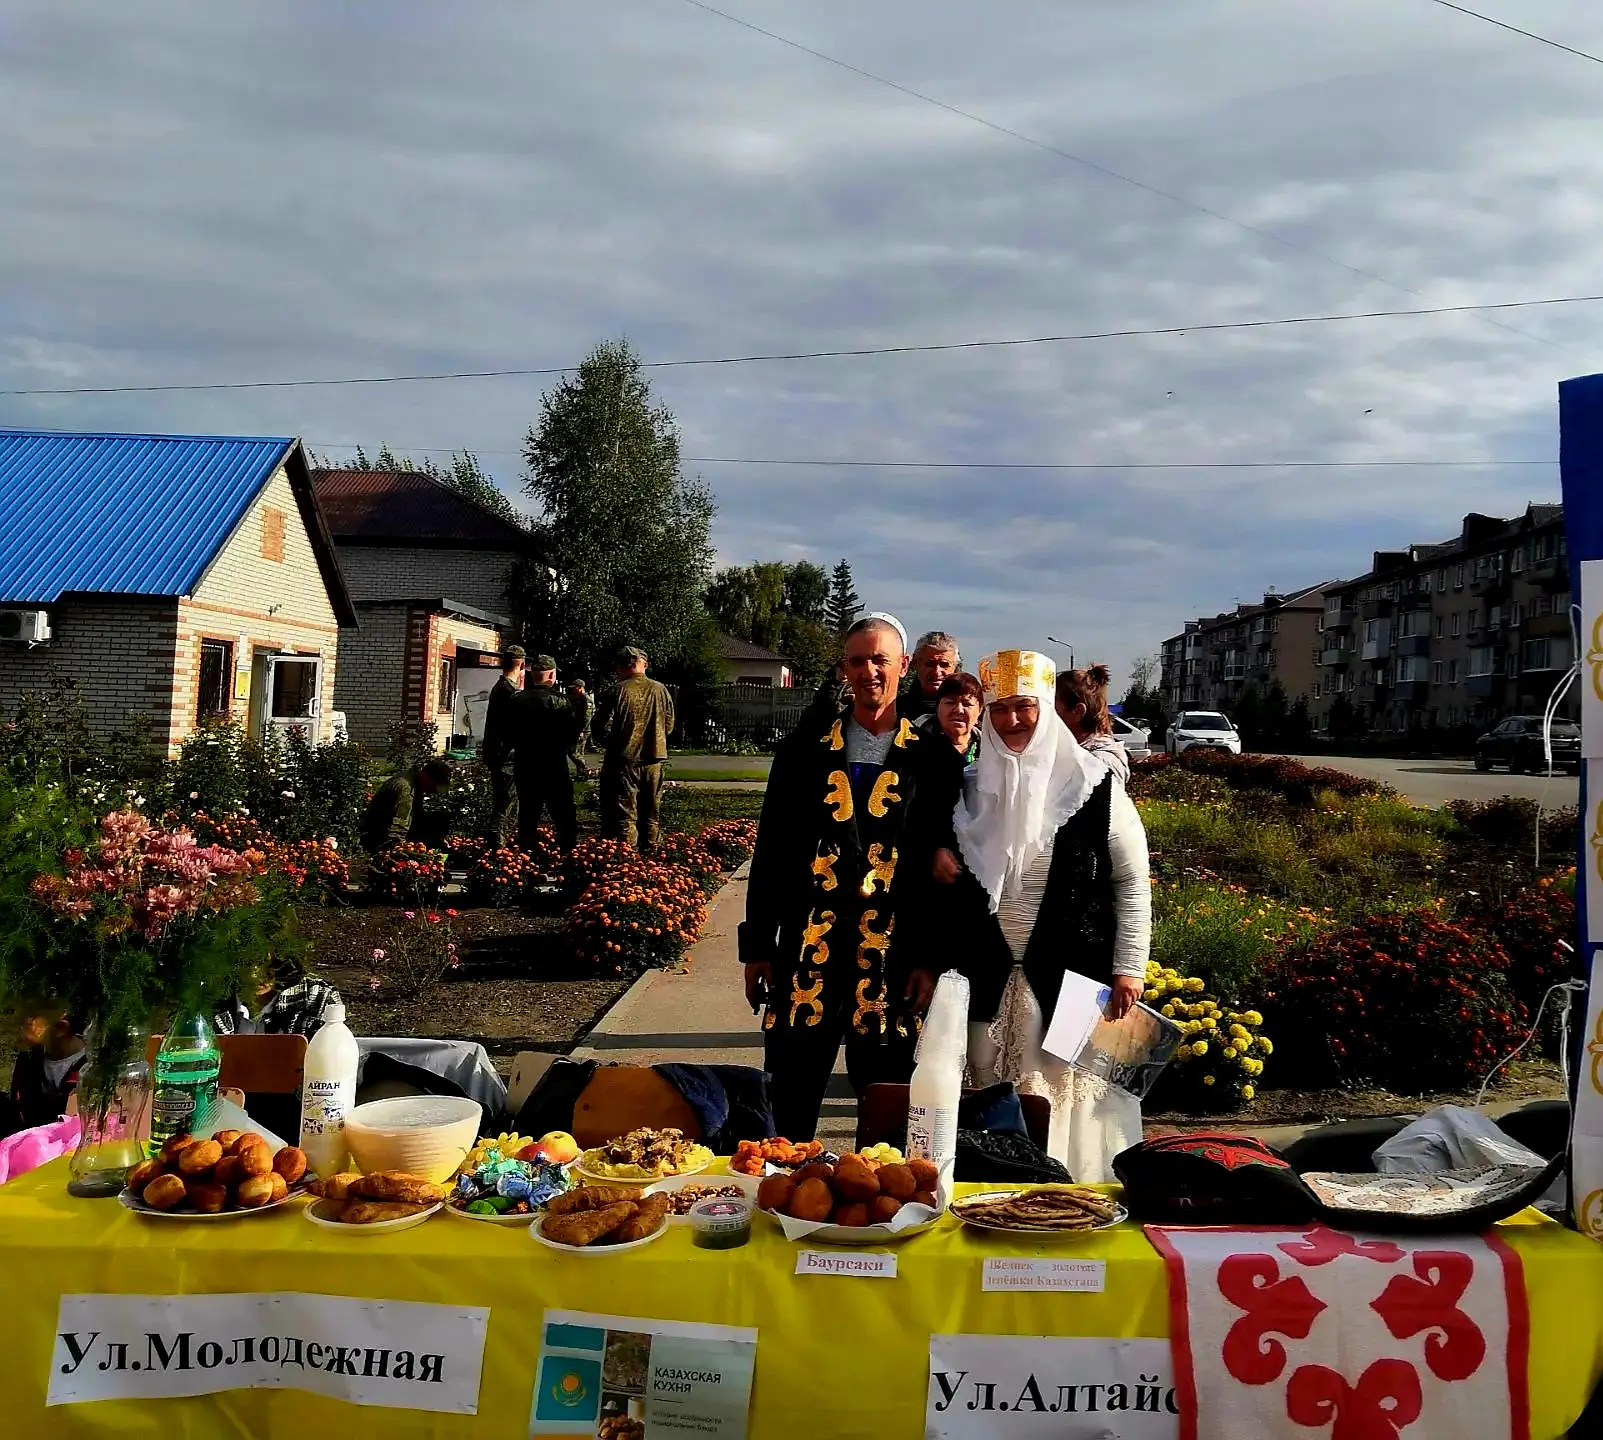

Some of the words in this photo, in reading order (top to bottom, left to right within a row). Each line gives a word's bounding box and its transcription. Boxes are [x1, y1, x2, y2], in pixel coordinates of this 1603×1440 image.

[308, 1080, 341, 1090] АЙРАН
[807, 1253, 885, 1272] Баурсаки
[57, 1331, 446, 1384] Ул.Молодежная
[655, 1367, 722, 1384] КАЗАХСКАЯ
[653, 1380, 692, 1393] КУХНЯ
